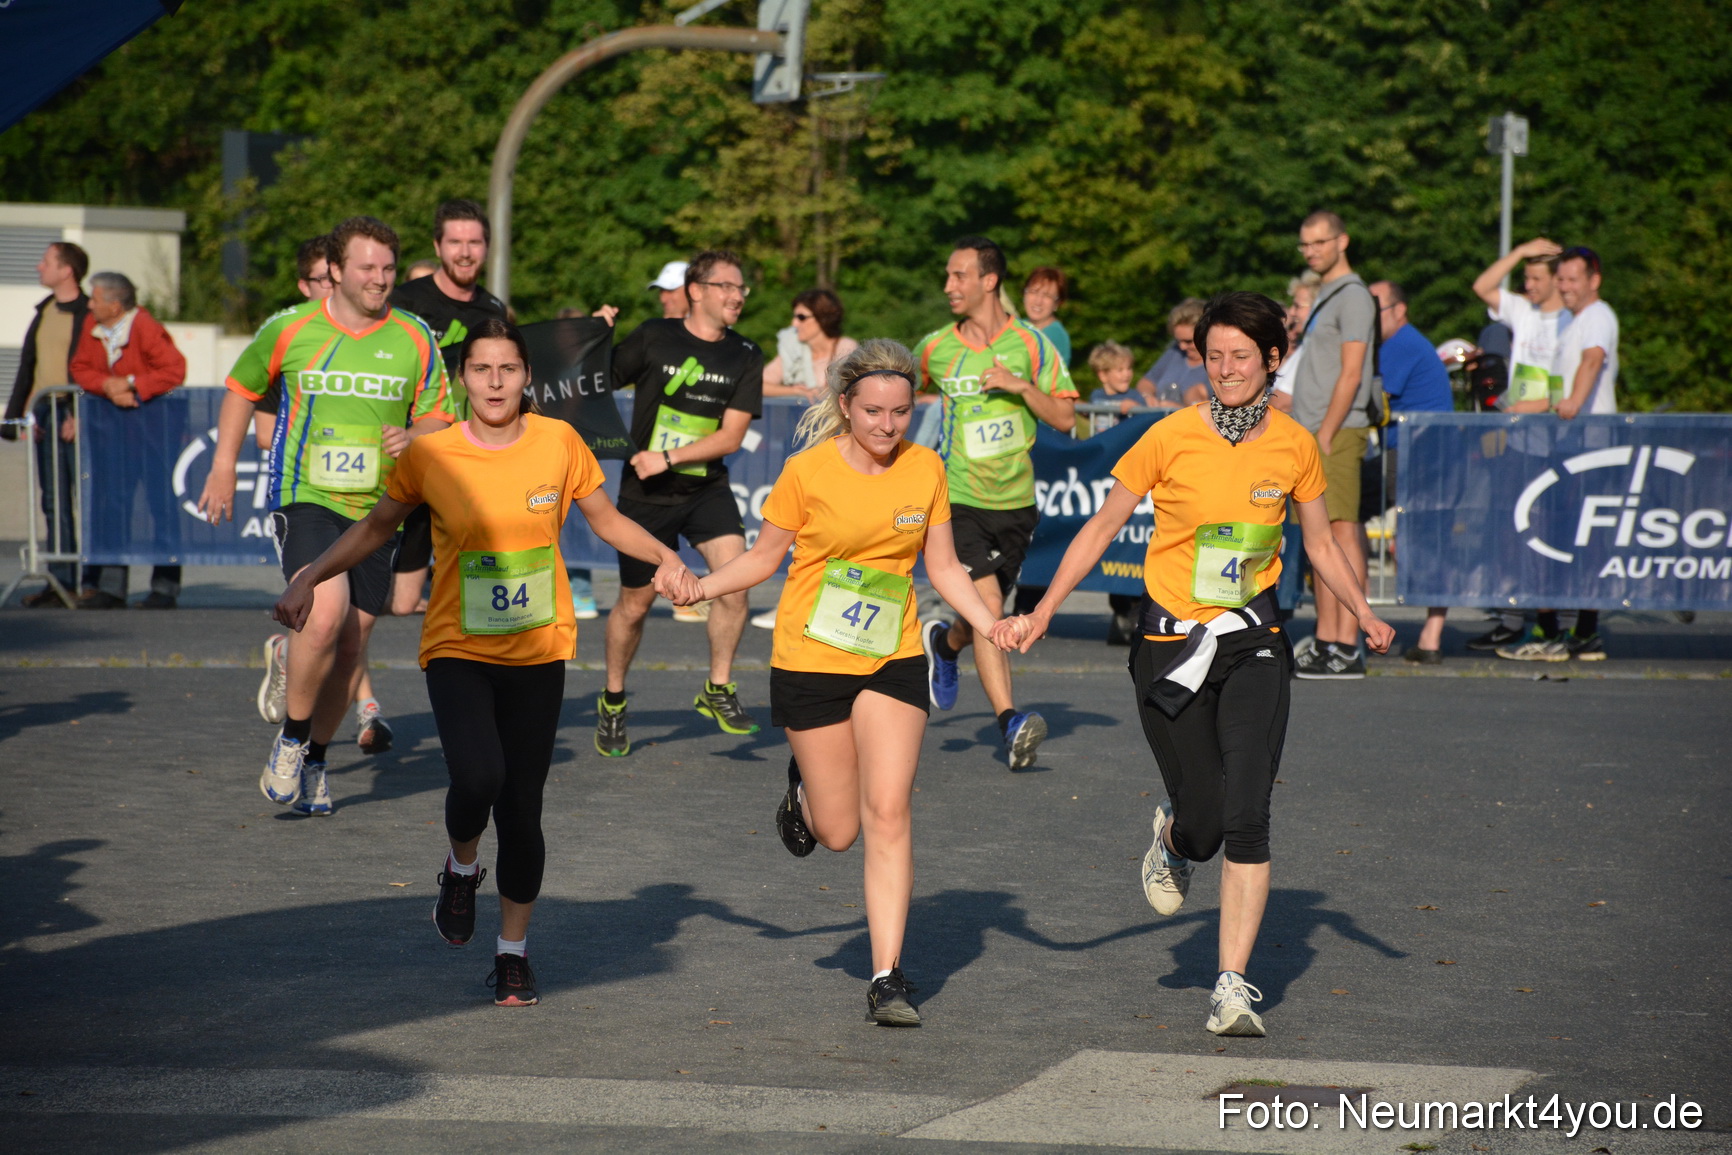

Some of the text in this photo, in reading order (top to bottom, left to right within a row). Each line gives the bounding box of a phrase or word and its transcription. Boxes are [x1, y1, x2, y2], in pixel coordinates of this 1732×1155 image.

[299, 371, 408, 400] BOCK
[660, 432, 694, 450] 11
[976, 420, 1014, 443] 123
[322, 451, 366, 473] 124
[1574, 495, 1732, 548] Fisc
[491, 583, 530, 611] 84
[1218, 588, 1234, 596] Tanja
[841, 600, 881, 631] 47
[834, 628, 855, 640] Kerstin
[856, 635, 874, 645] Kupfer
